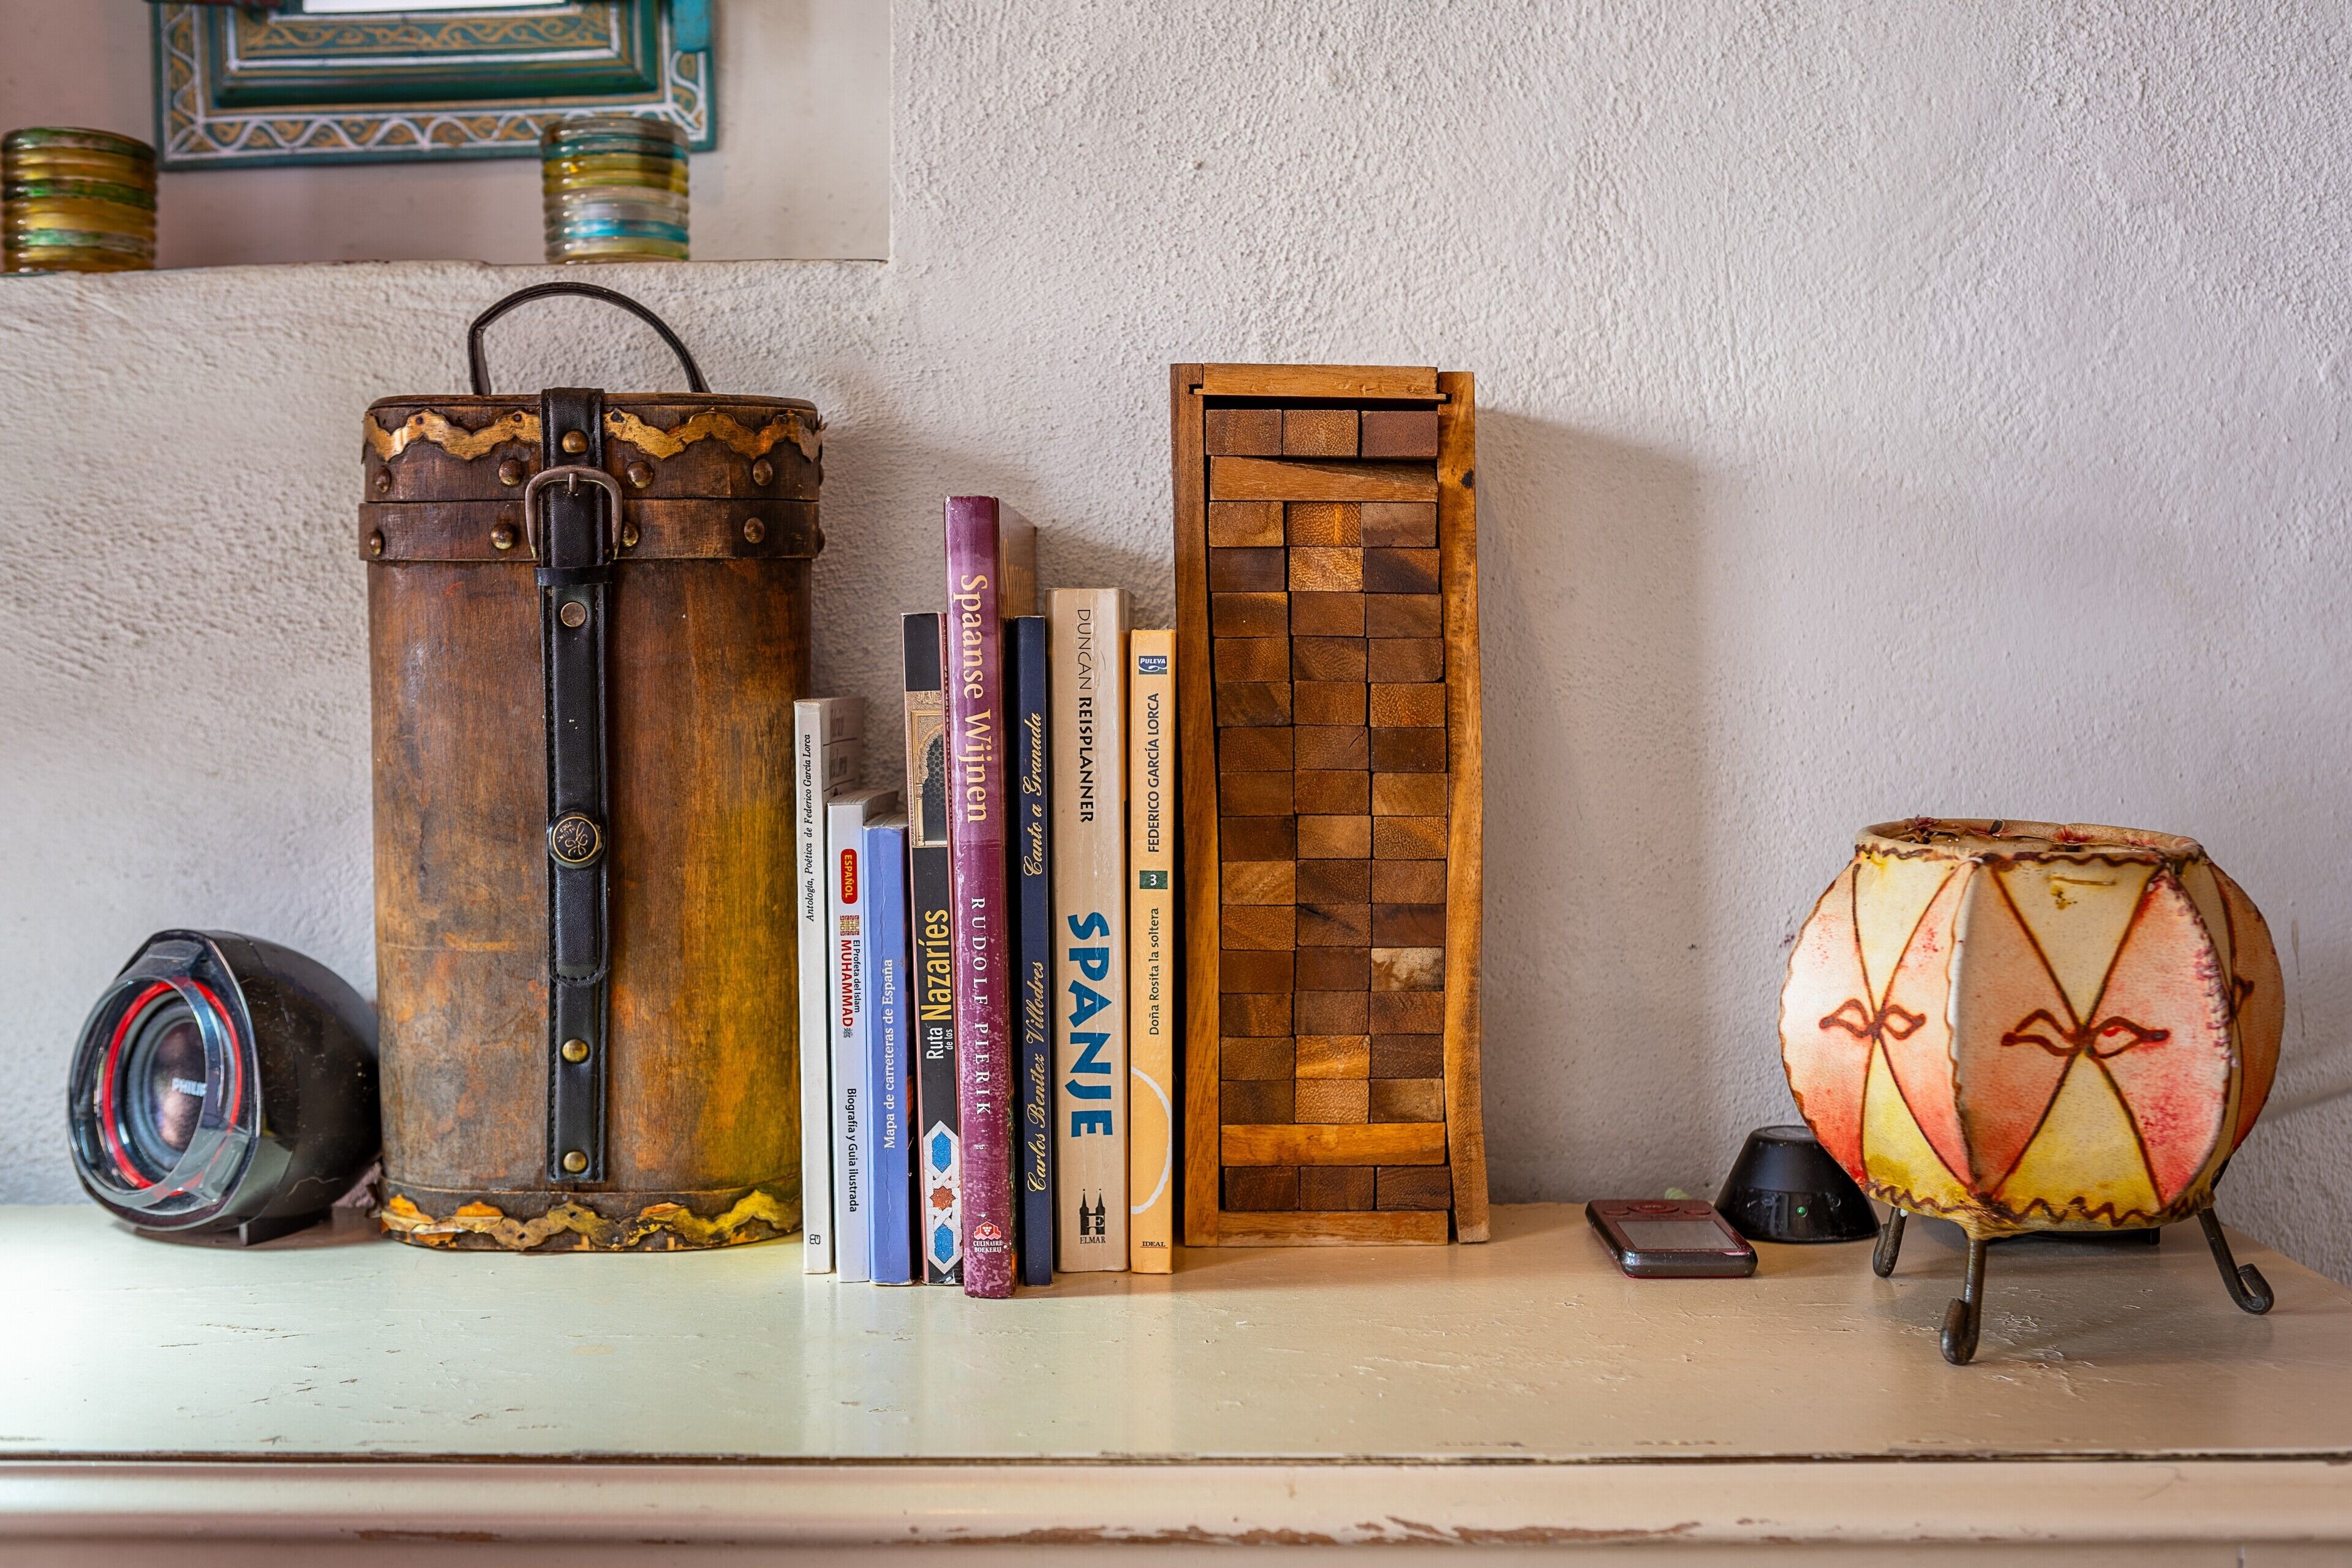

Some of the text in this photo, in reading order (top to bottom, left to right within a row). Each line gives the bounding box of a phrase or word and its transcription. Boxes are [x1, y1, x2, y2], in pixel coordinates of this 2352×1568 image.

[953, 575, 992, 823] Spaanse Wijnen
[1077, 609, 1094, 823] DUNCAN REISPLANNER
[803, 760, 812, 786] García
[1023, 712, 1042, 876] Canto a Granada
[1145, 693, 1159, 853] FEDERICO GARCÍA LORCA
[804, 789, 813, 824] Federico
[804, 827, 812, 837] de
[804, 843, 813, 874] Poética
[845, 854, 854, 898] ESPAÑOL
[1150, 875, 1157, 886] 3
[805, 878, 815, 922] Antología,
[841, 940, 853, 1027] MUHAMMAD
[918, 909, 952, 1020] Nazaríes
[1148, 908, 1159, 1035] Doña Rosita la soltera
[971, 897, 990, 1115] RUDOLF PIERIK
[1025, 962, 1044, 1044] Villodres
[1065, 912, 1113, 1137] SPANJE
[882, 960, 897, 1148] Mapa de carreteras de España
[926, 1028, 944, 1059] Ruta
[944, 1029, 953, 1050] de los
[845, 1088, 858, 1133] Biografía
[848, 1144, 858, 1167] Guia
[1028, 1132, 1046, 1192] Carlos
[848, 1168, 859, 1212] ilustrada
